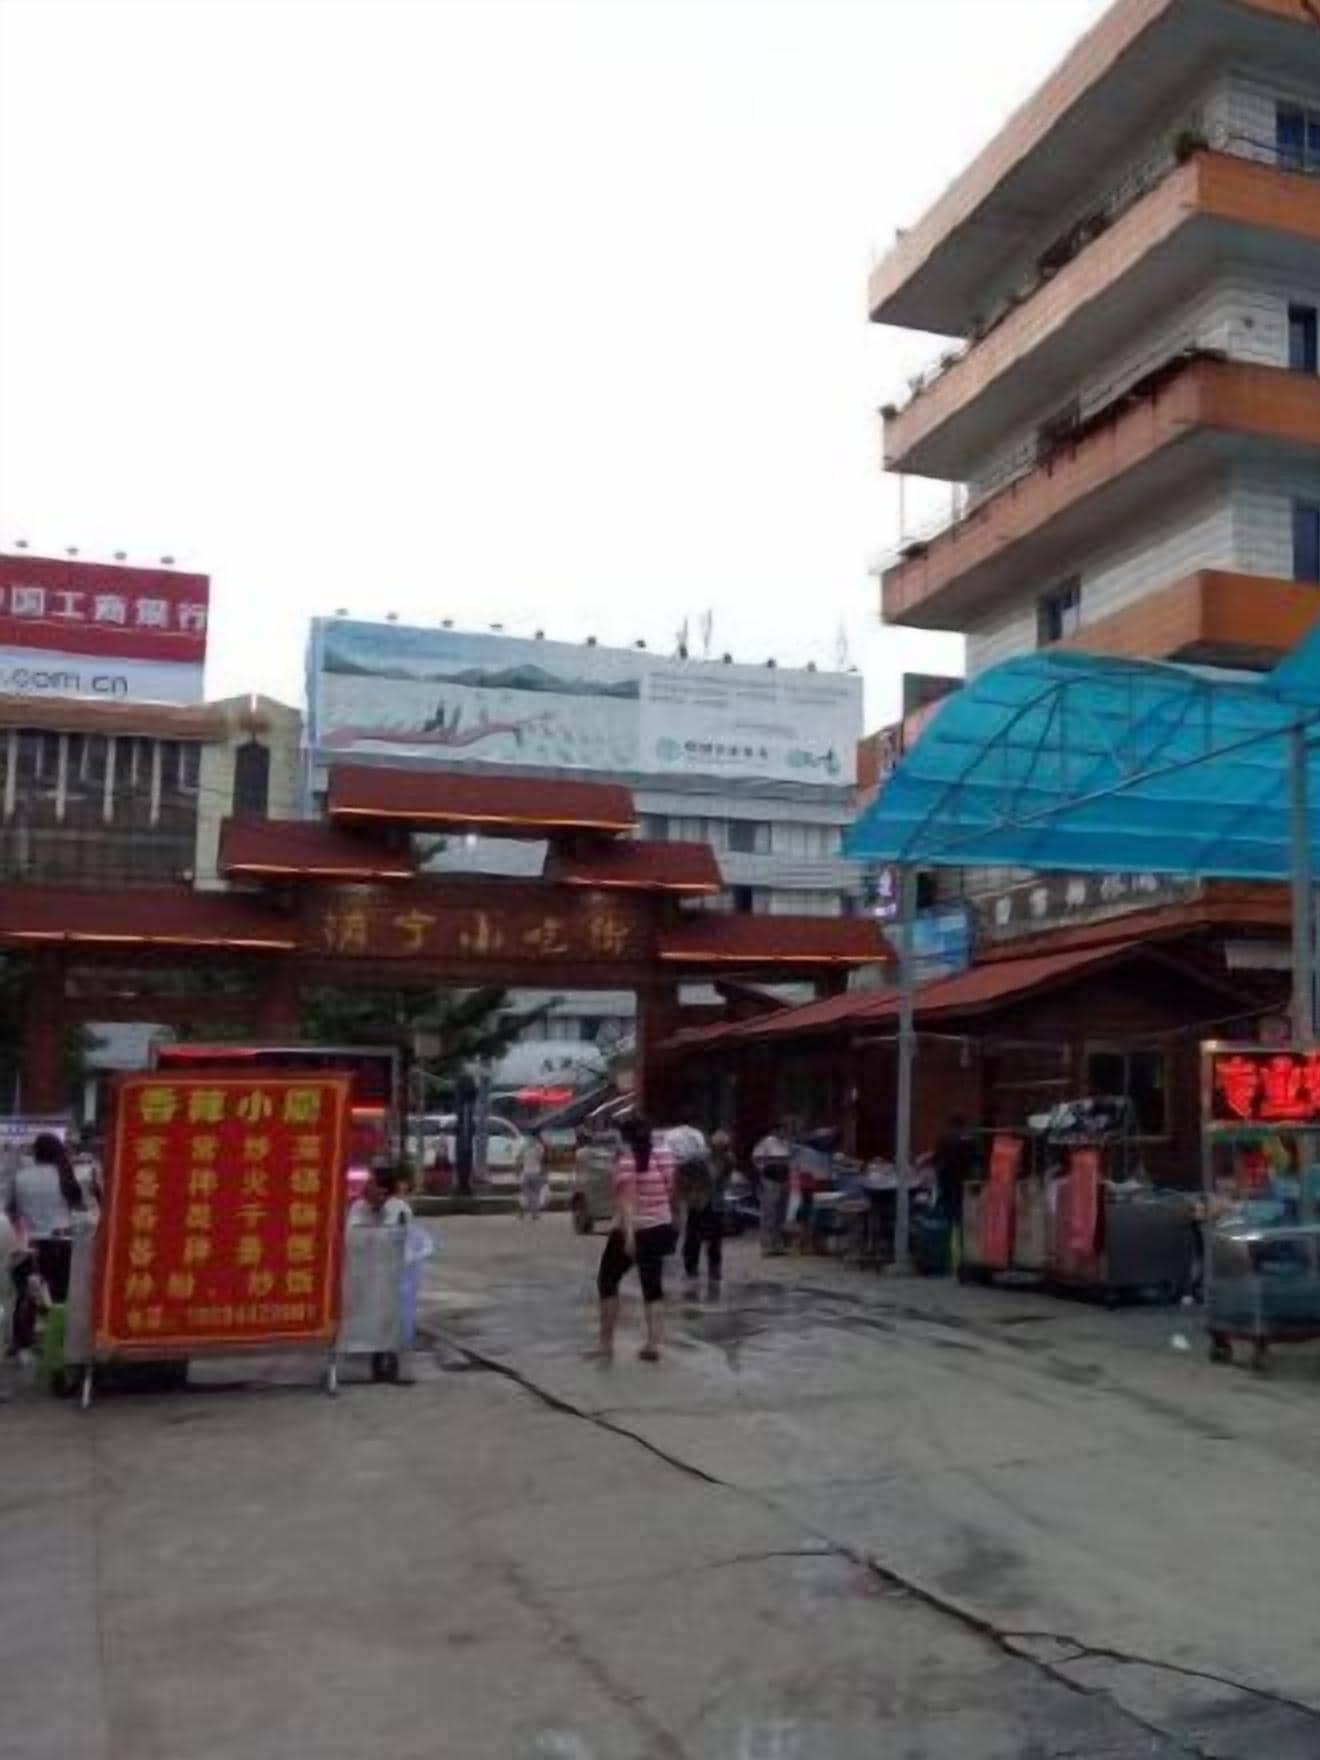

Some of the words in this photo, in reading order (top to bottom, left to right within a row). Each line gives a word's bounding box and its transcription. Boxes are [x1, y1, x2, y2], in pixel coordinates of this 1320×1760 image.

[0, 586, 208, 631] 国工商银行
